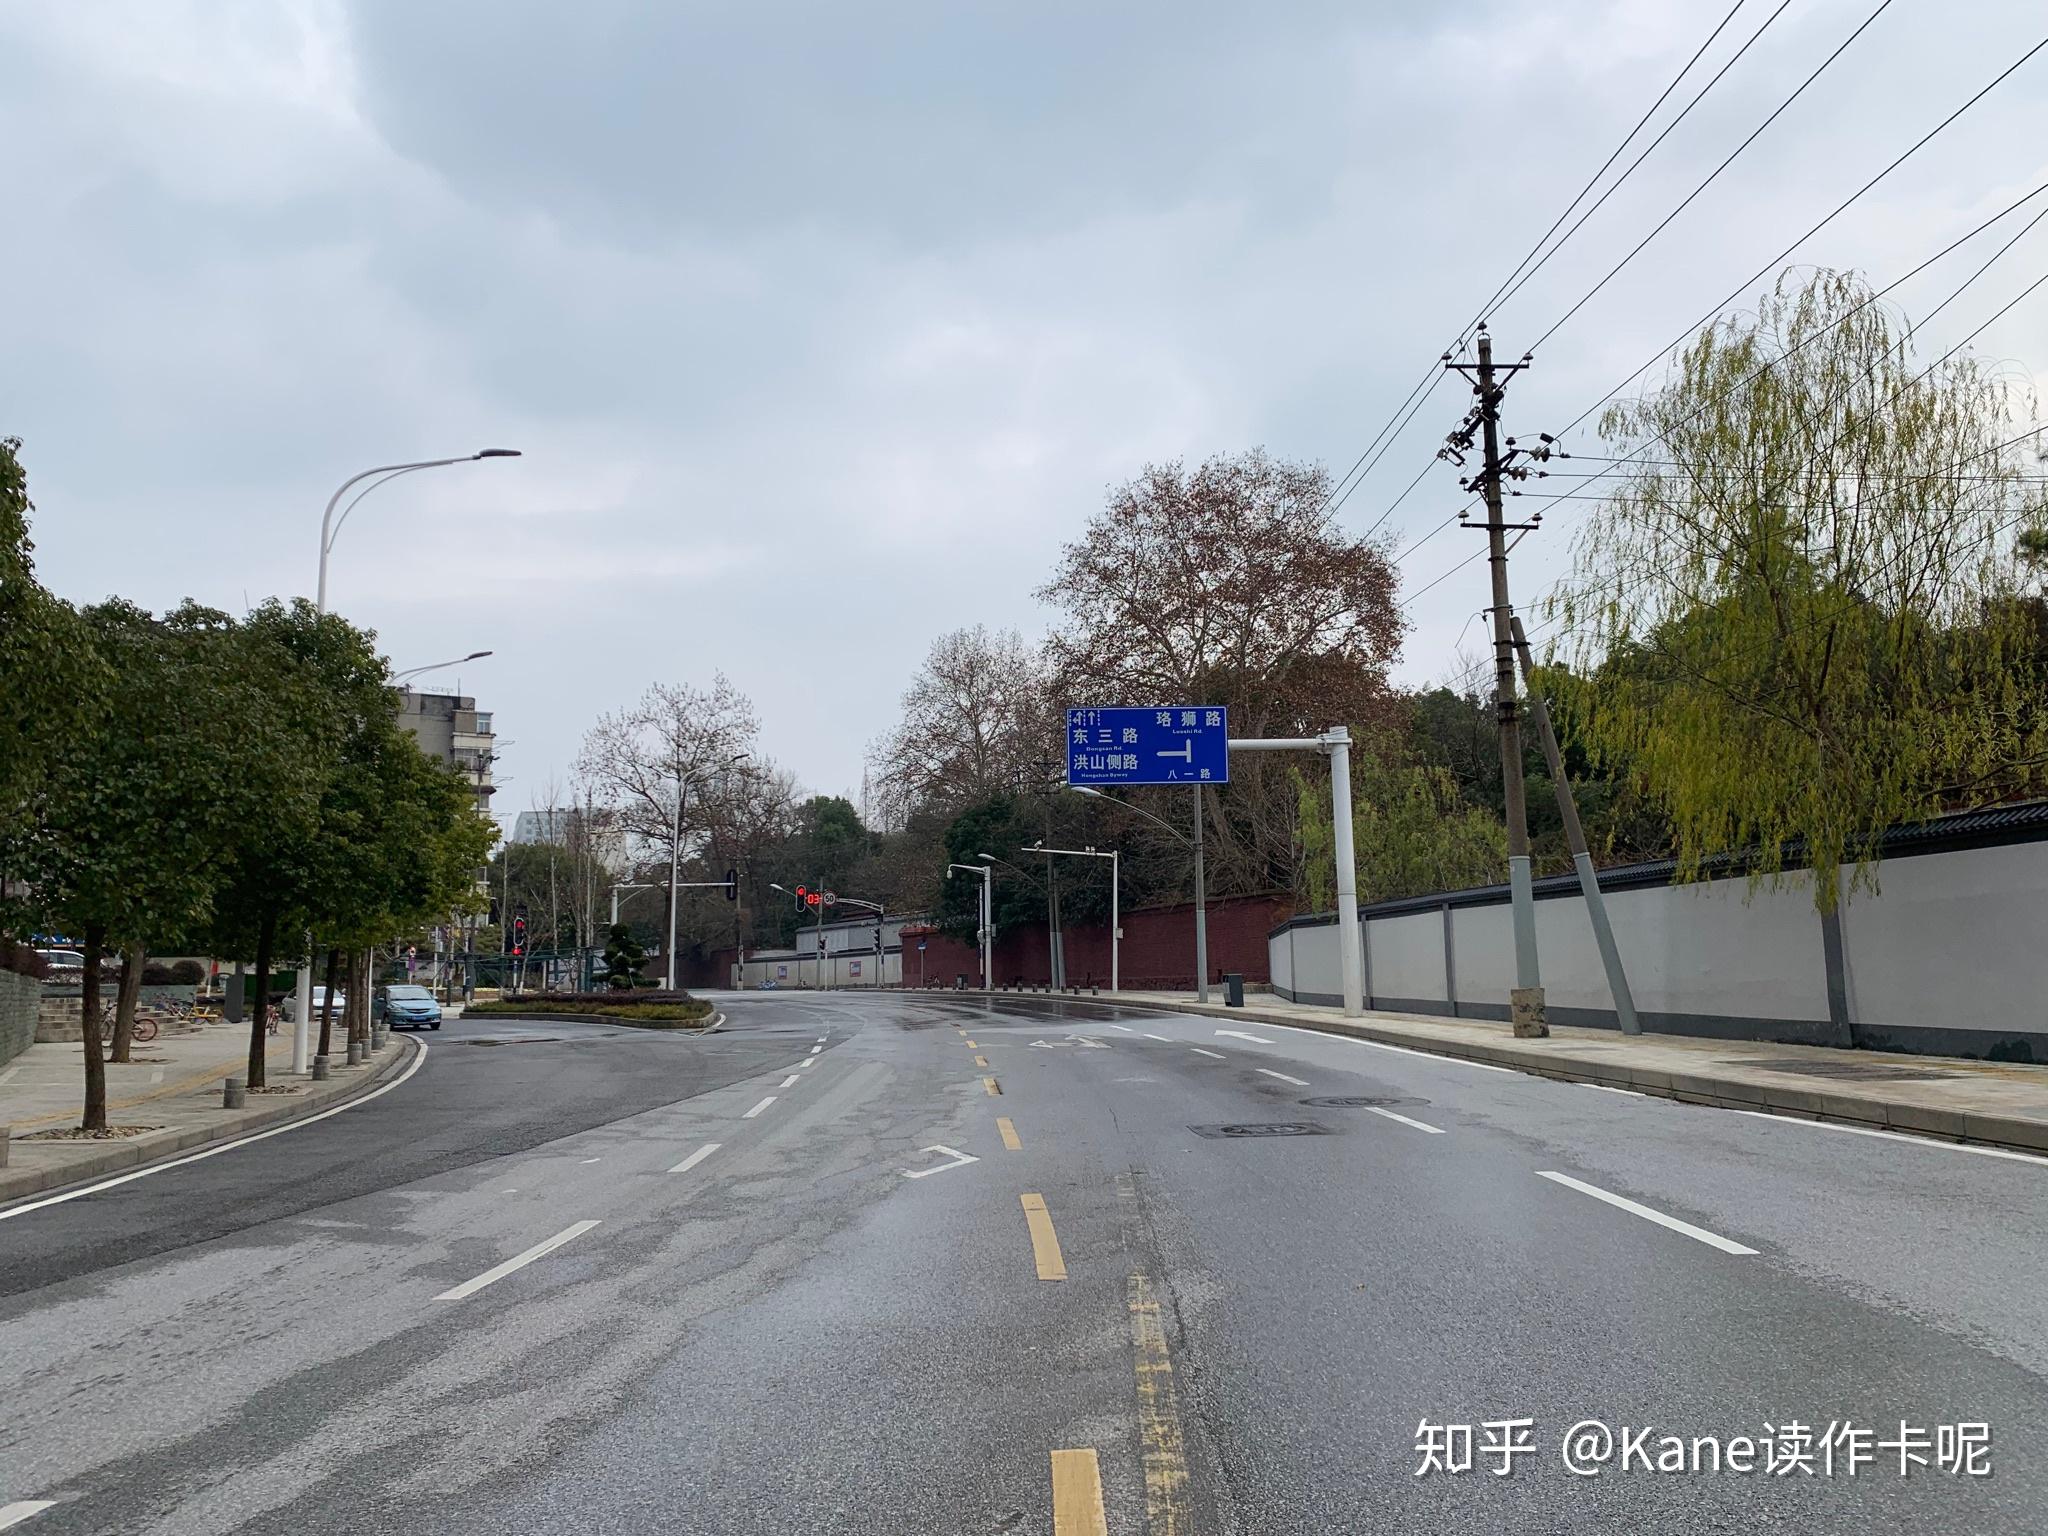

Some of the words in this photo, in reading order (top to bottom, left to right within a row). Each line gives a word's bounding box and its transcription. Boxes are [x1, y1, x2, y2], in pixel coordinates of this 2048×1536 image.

[1156, 711, 1221, 727] 珞狮路
[1073, 728, 1138, 744] 东三路
[1073, 754, 1138, 770] 洪山侧路
[1167, 768, 1210, 779] 八一路
